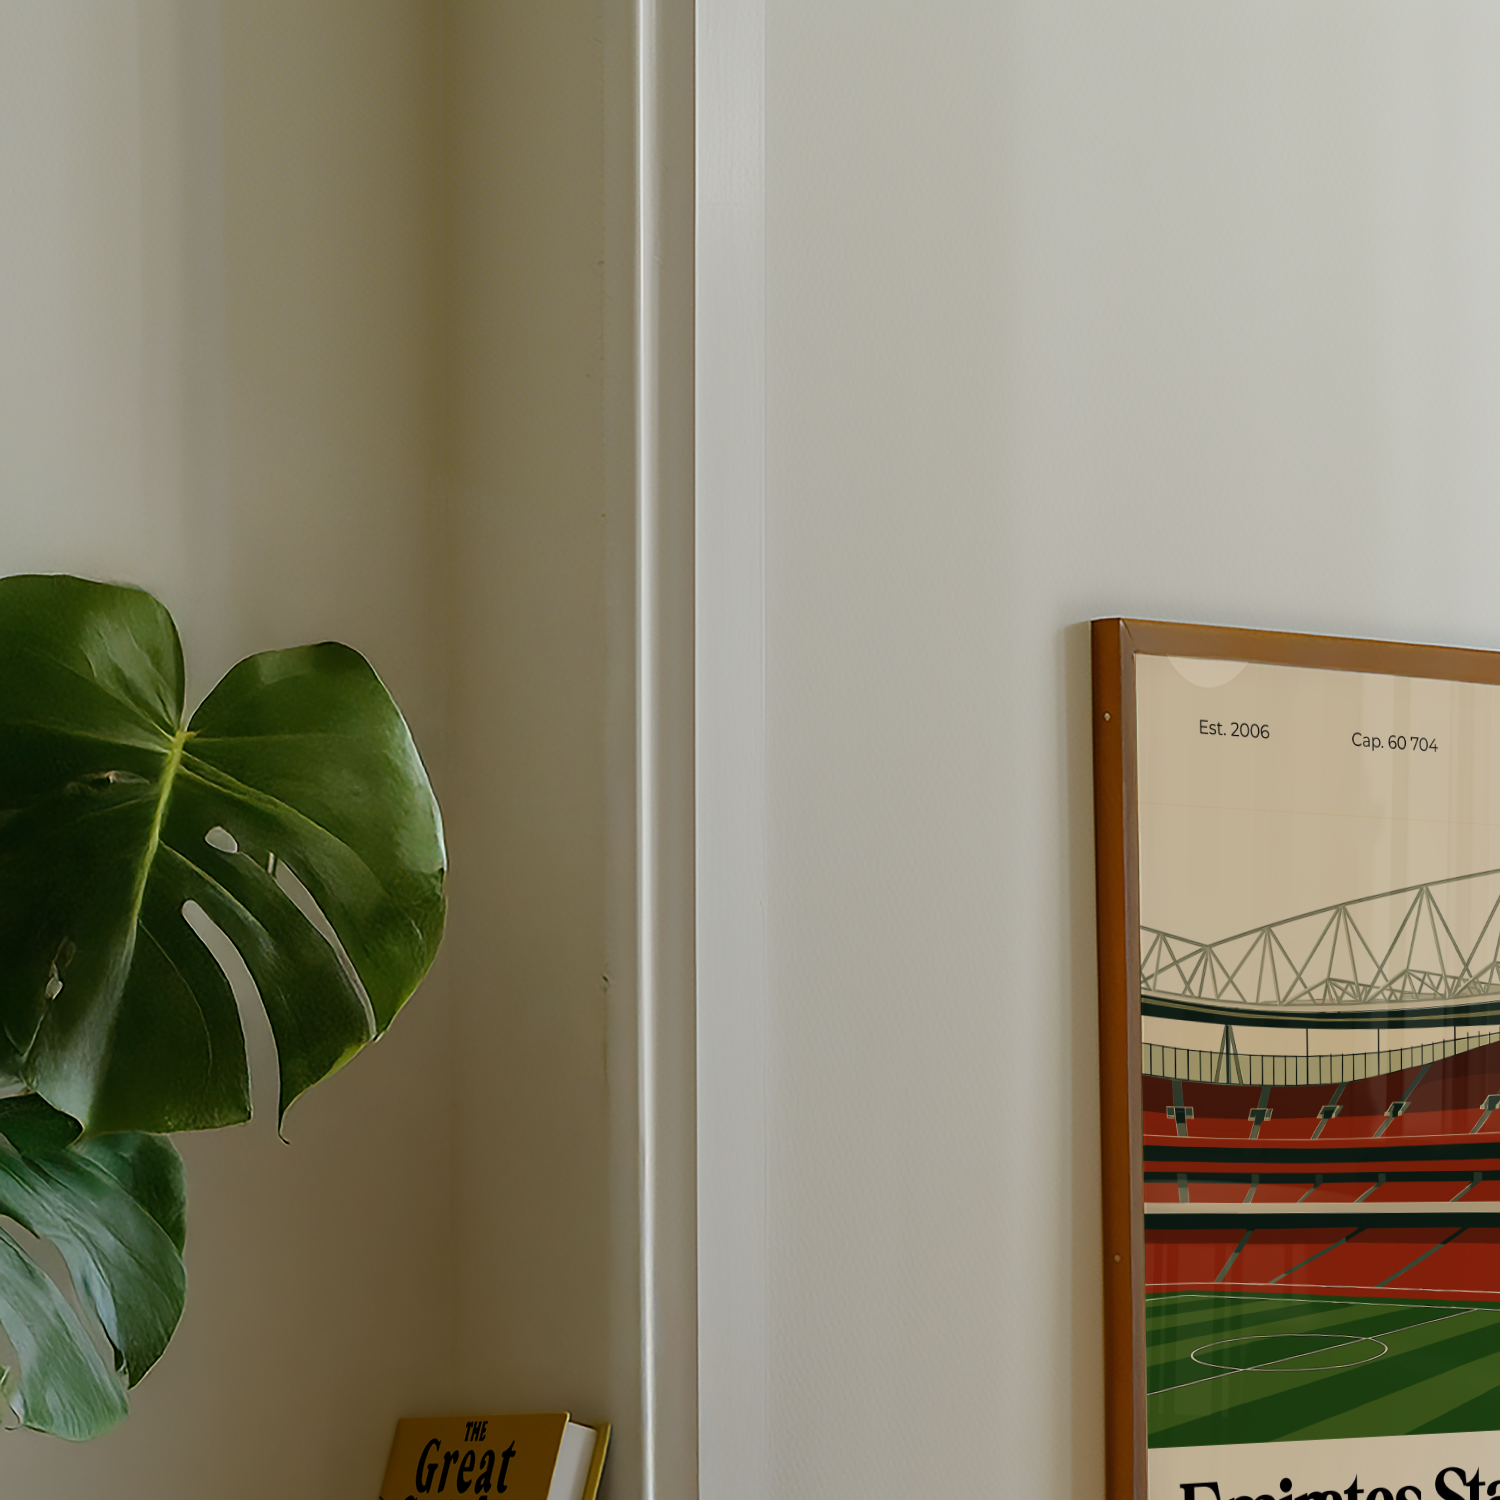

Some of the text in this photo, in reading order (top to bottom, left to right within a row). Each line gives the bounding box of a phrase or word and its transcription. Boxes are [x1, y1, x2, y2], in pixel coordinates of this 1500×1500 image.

[1199, 719, 1270, 740] Est. 2006
[1351, 732, 1439, 753] Cap. 60 704
[464, 1421, 488, 1442] THE
[415, 1438, 517, 1495] Great
